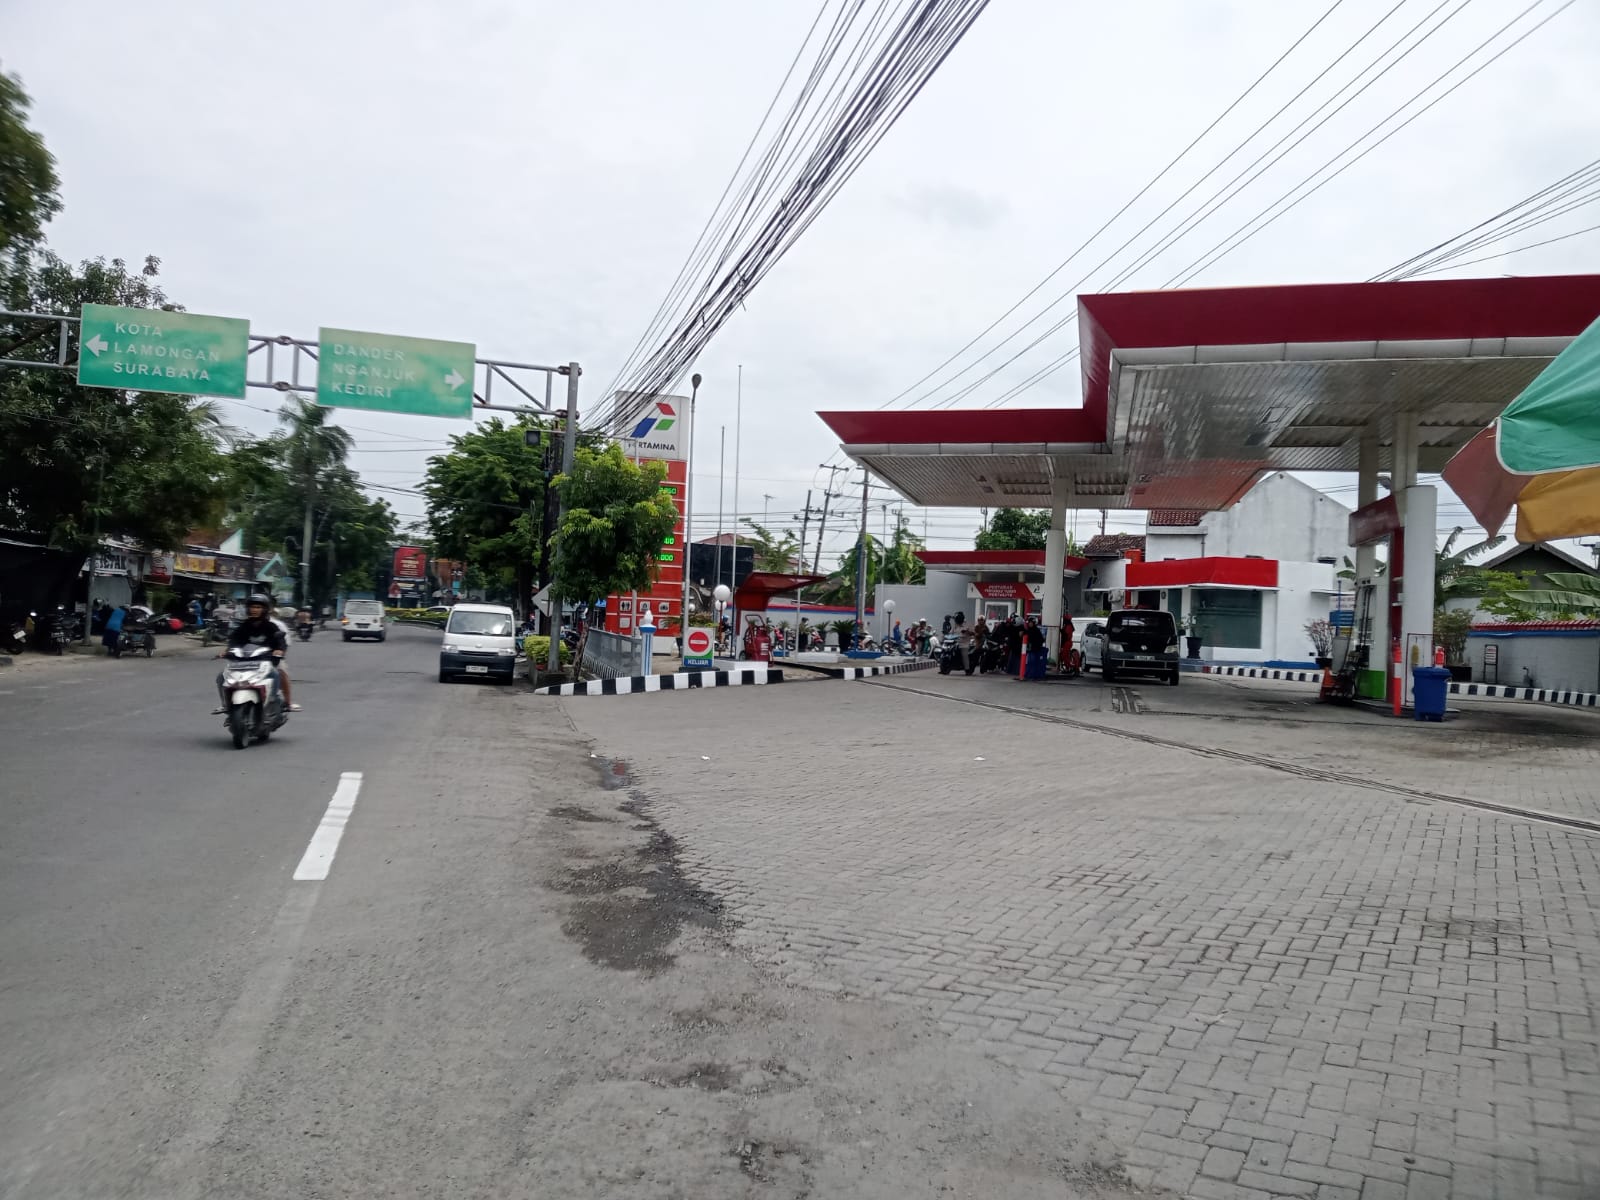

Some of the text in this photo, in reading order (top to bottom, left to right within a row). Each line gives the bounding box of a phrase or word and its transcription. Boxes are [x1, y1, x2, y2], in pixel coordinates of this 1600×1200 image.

[115, 322, 163, 337] KOTA
[114, 342, 220, 361] LAMONGAN
[333, 344, 405, 361] DANDER
[113, 362, 210, 381] SURABAYA
[333, 363, 416, 382] NGANJUK
[331, 383, 392, 399] KEDIRI
